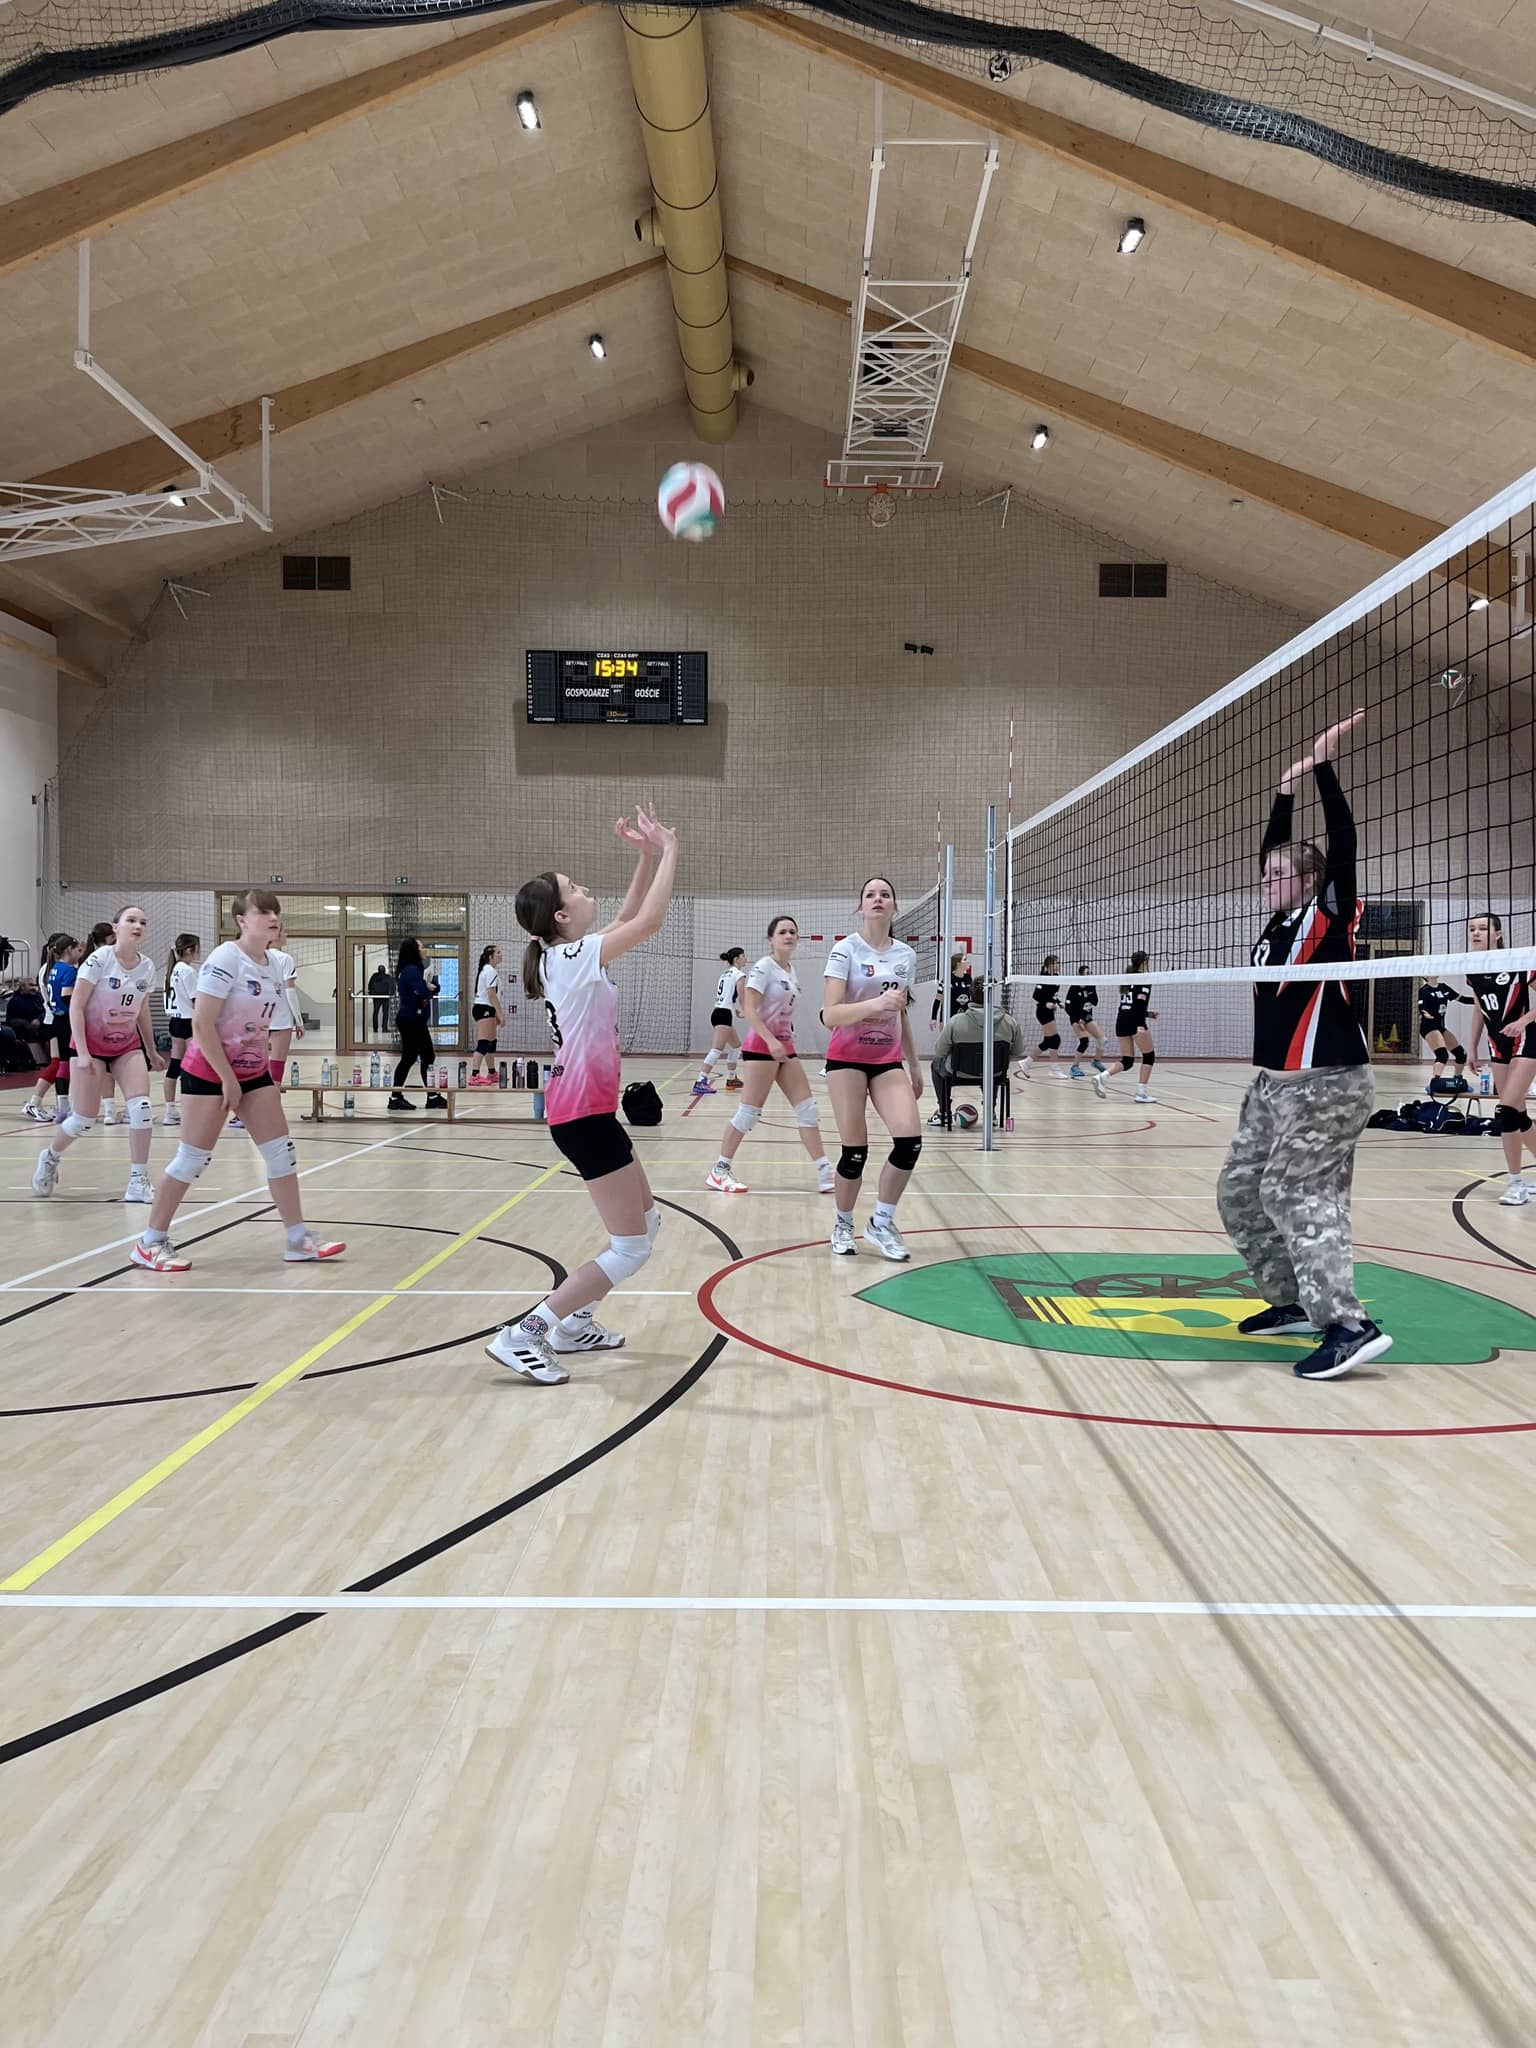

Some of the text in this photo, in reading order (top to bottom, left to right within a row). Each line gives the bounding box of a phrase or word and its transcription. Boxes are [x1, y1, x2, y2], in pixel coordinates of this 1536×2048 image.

[595, 660, 638, 677] 15:34
[565, 688, 610, 698] GOSPODARZE
[634, 686, 660, 698] GOŚCIE
[120, 993, 134, 1007] 19
[260, 1001, 276, 1018] 11
